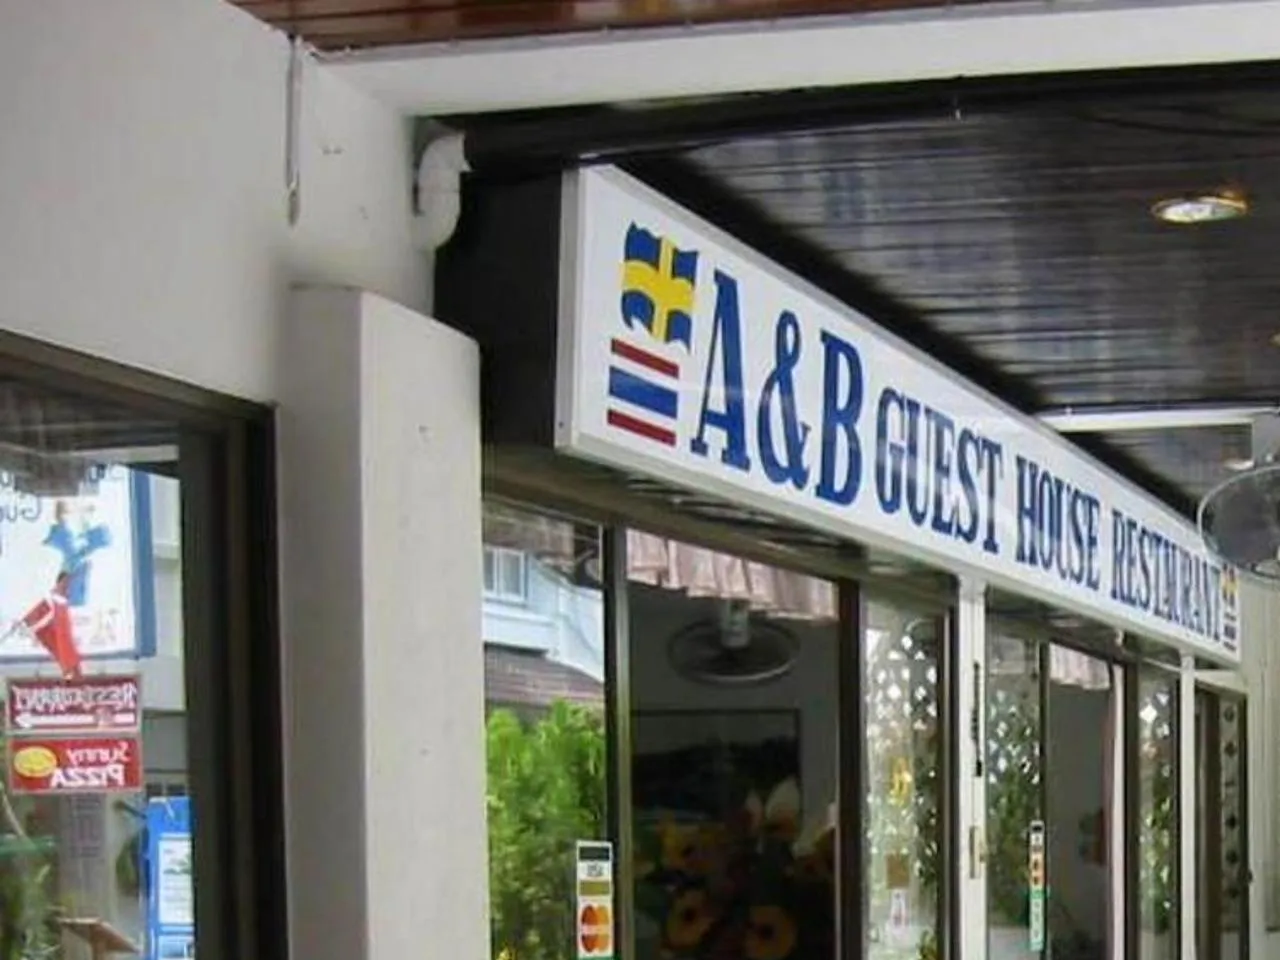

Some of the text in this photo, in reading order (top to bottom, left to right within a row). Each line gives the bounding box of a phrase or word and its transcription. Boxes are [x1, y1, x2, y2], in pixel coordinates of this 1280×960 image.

[691, 270, 1222, 642] A&B GUEST HOUSE RESTAURANT
